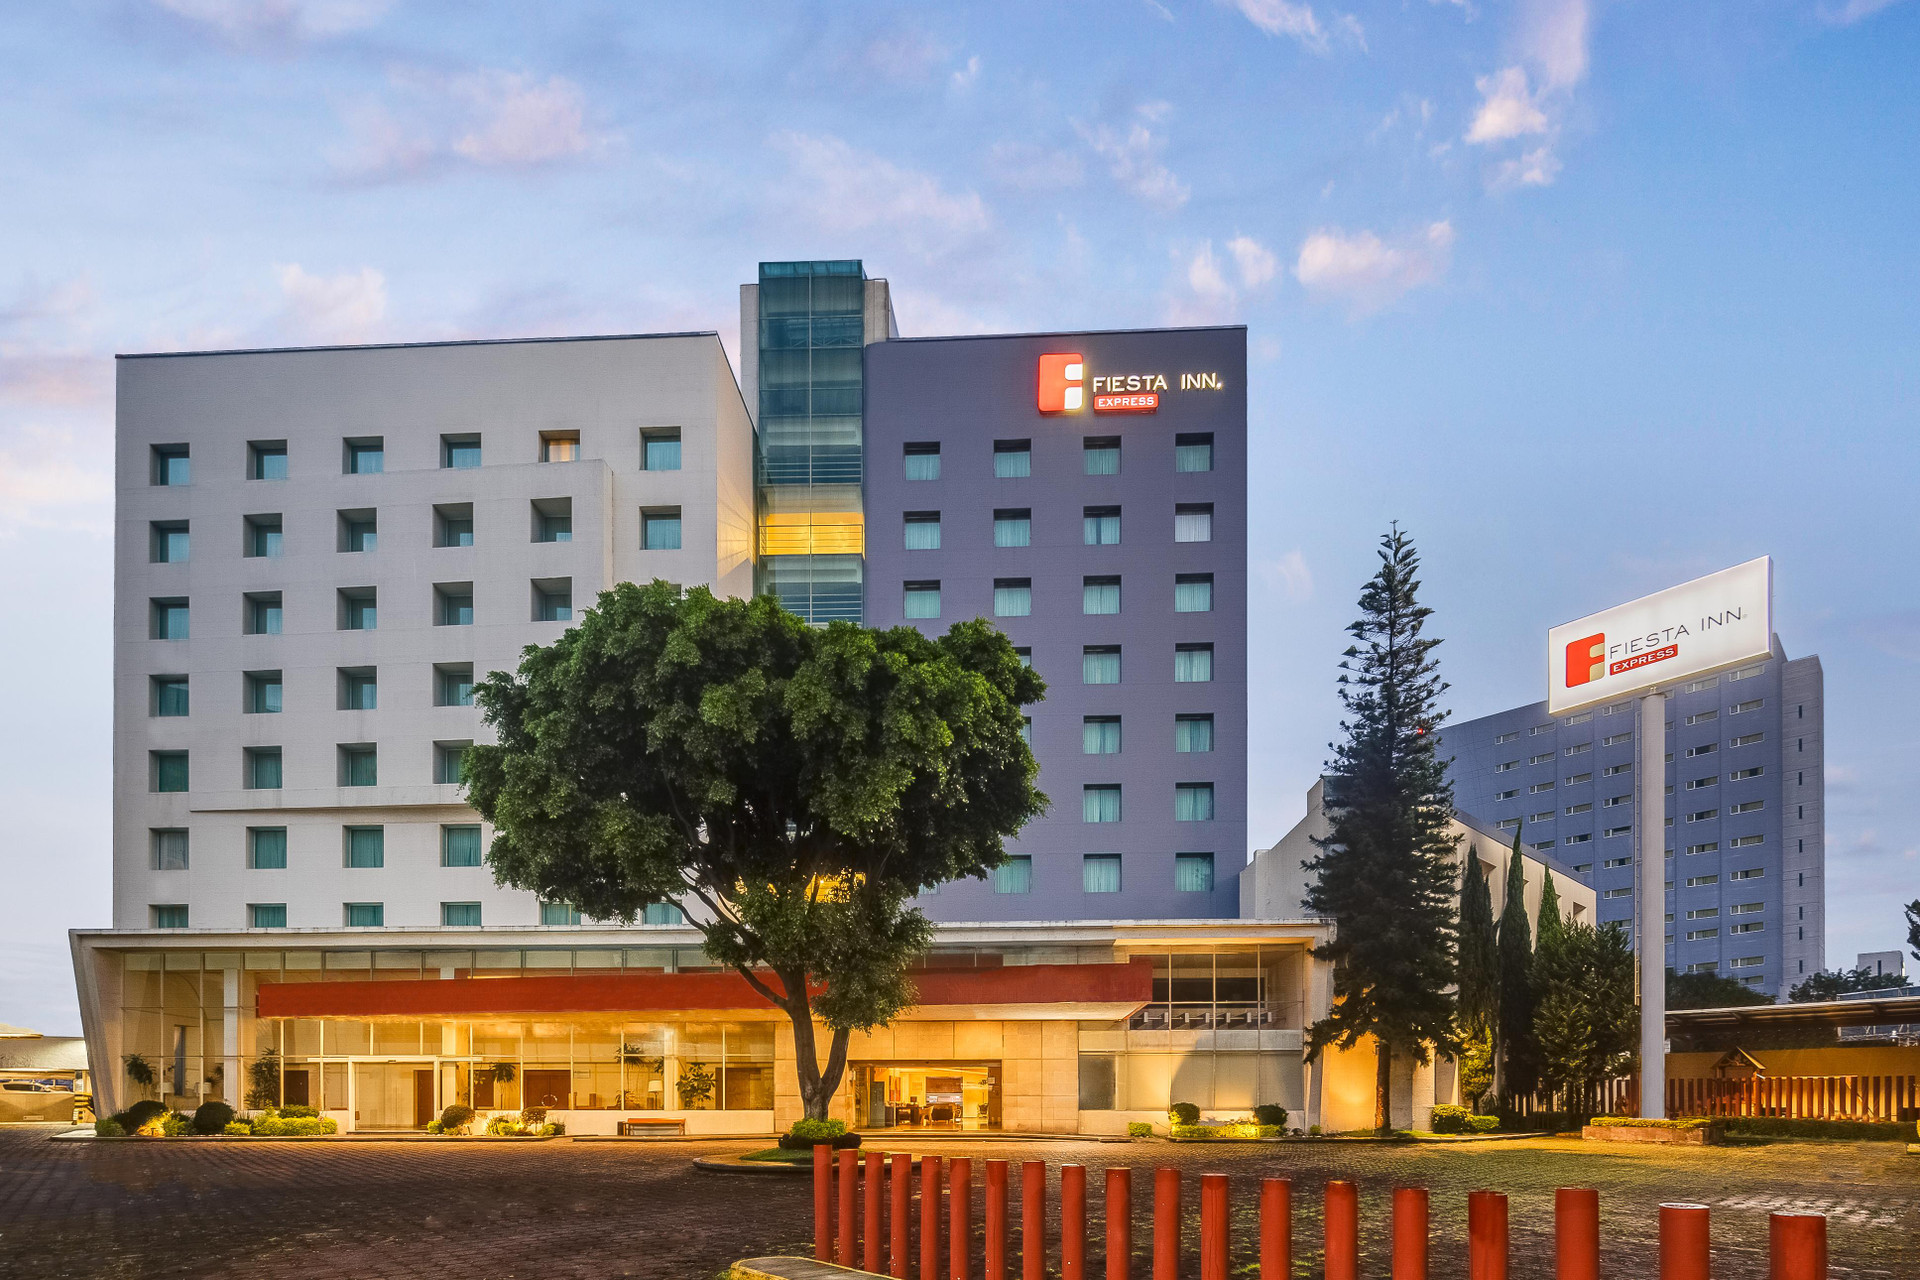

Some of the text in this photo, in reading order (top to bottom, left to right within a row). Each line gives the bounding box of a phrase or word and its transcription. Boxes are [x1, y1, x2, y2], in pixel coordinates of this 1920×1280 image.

[1092, 374, 1168, 392] FIESTA
[1098, 396, 1155, 408] EXPRESS
[1609, 624, 1690, 659] FIESTA
[1612, 647, 1675, 673] EXPRESS
